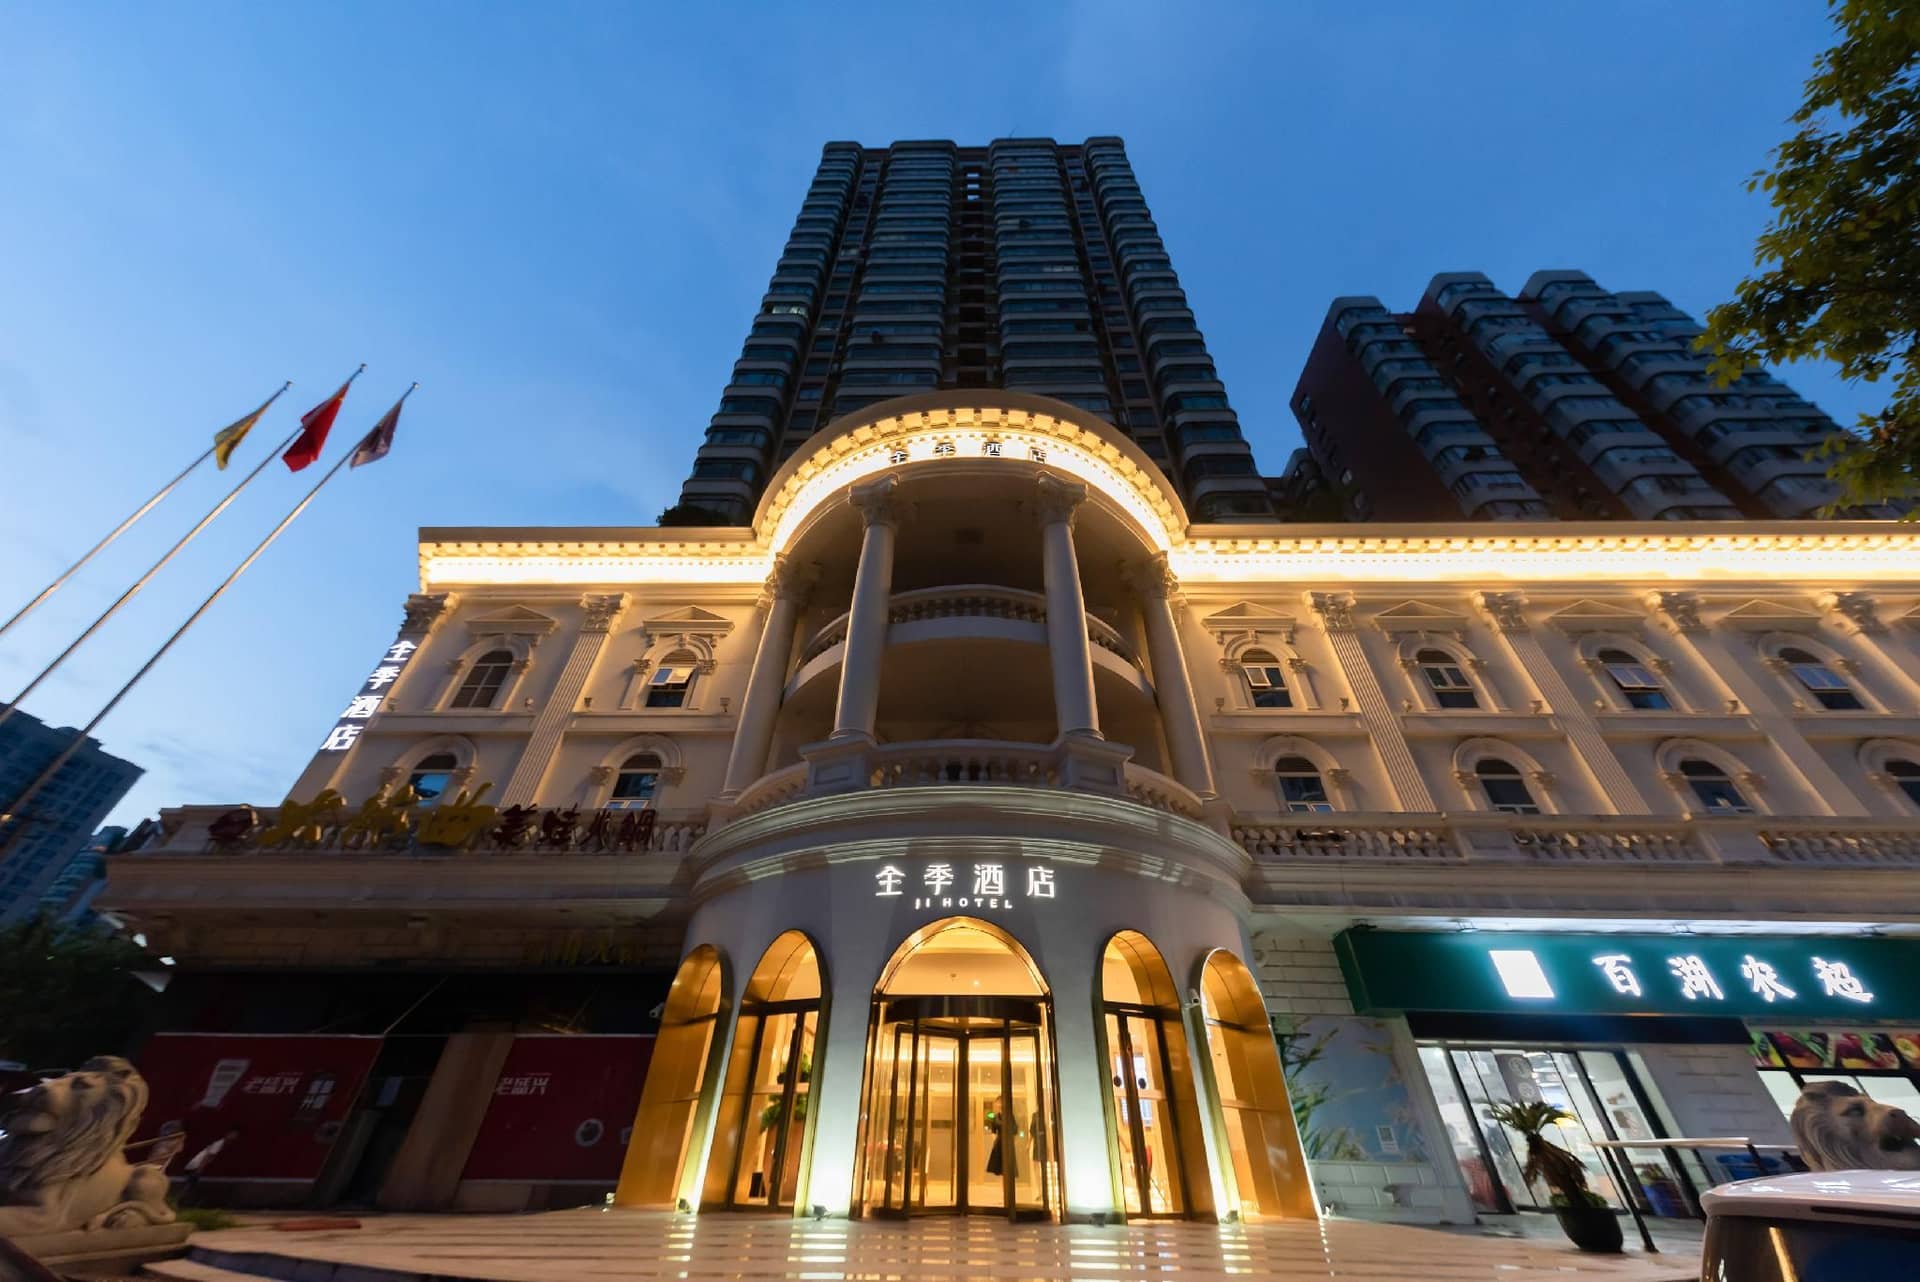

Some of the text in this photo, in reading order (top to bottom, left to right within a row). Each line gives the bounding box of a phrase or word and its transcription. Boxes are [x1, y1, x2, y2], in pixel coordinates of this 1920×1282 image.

[320, 640, 418, 750] 全季酒店
[875, 864, 1056, 898] 全季酒店
[915, 897, 1014, 910] JI HOTEL
